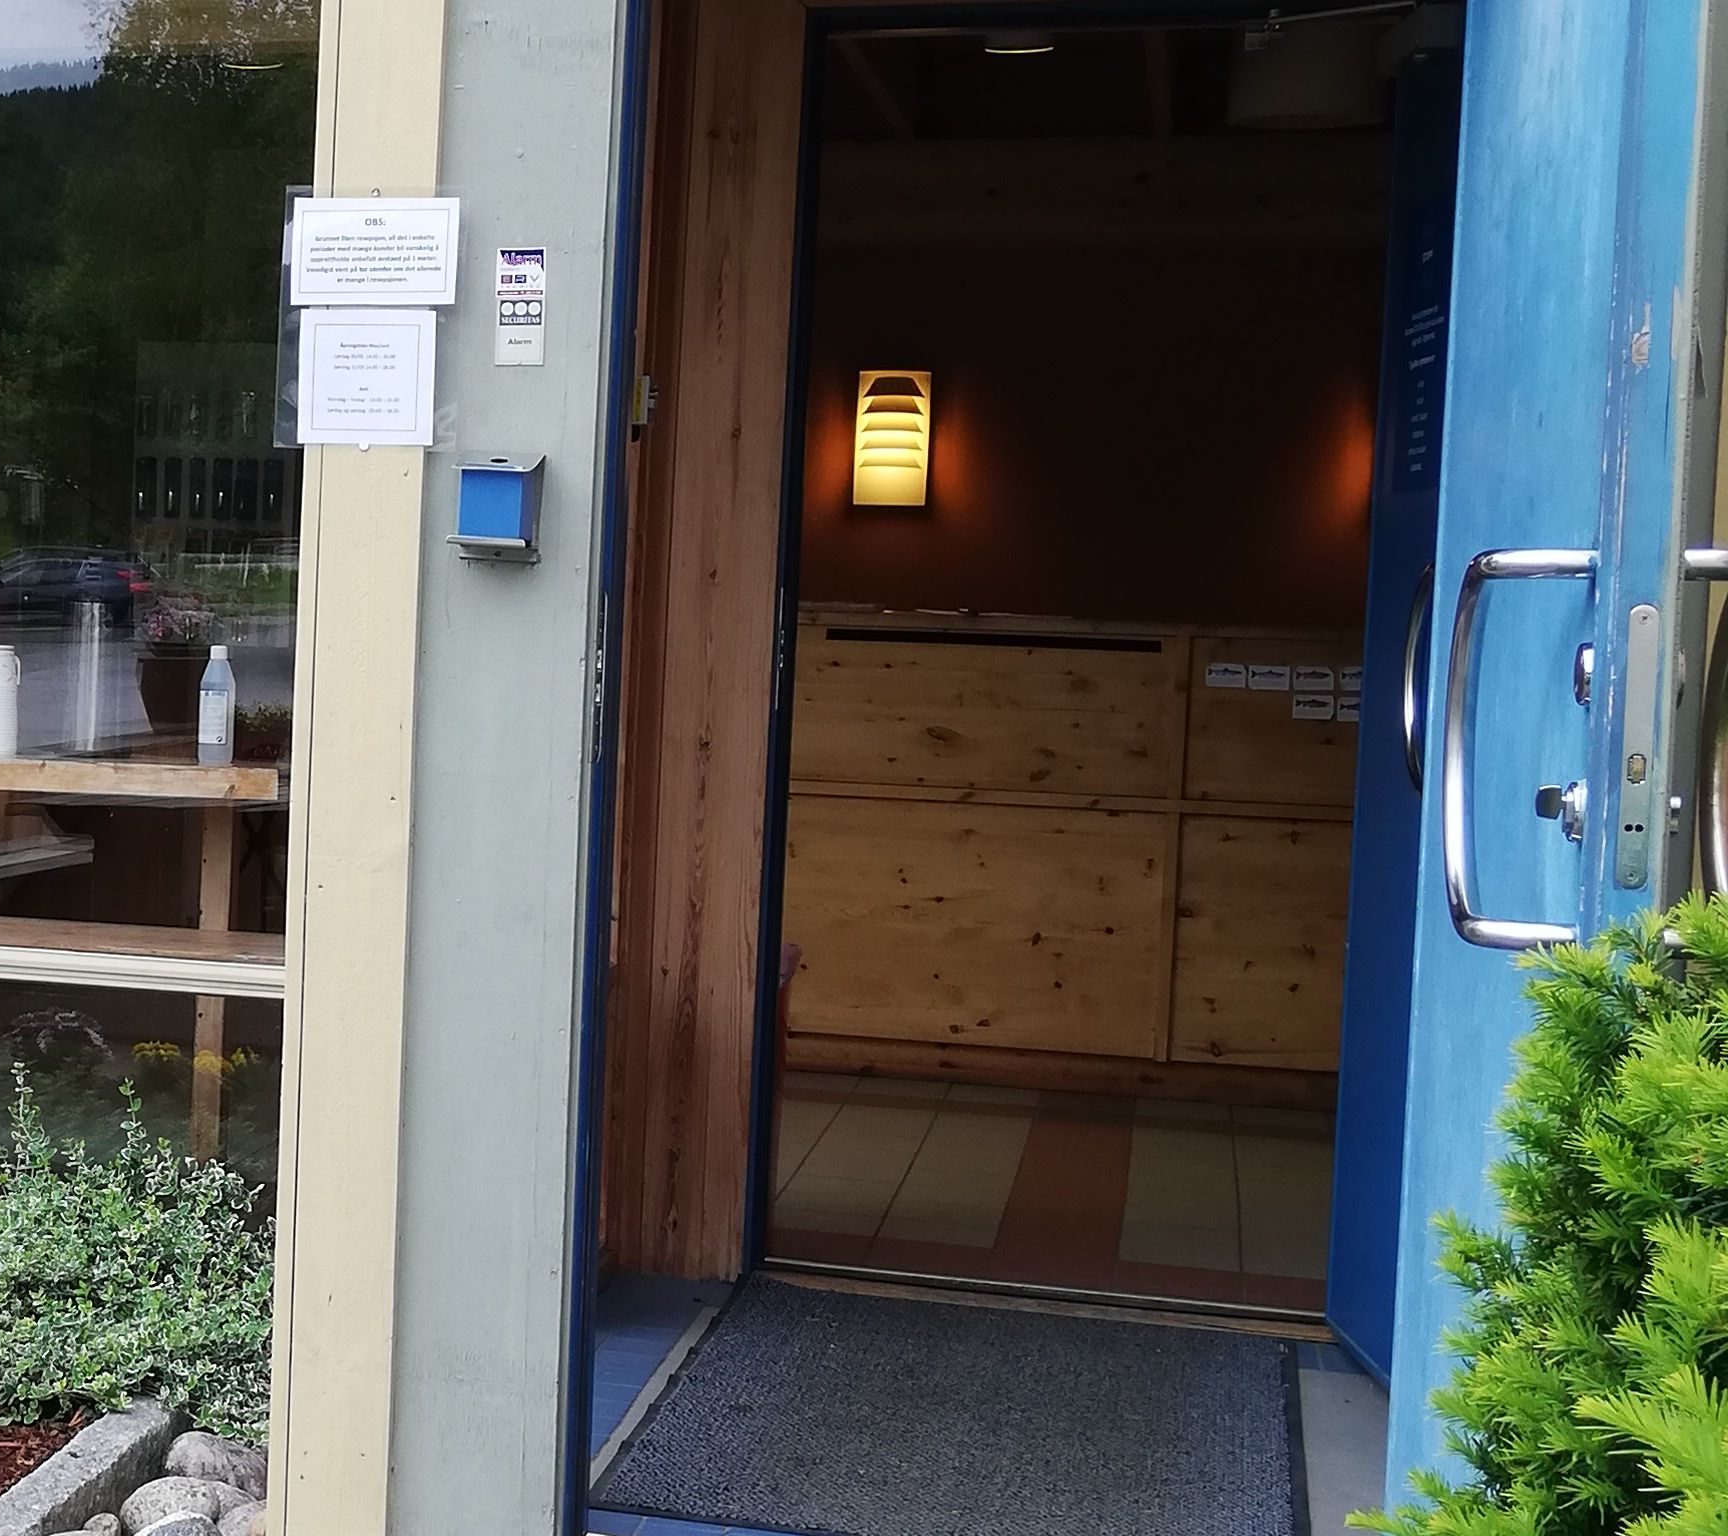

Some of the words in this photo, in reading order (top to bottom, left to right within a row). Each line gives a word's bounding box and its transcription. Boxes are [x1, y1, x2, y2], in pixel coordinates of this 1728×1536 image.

[365, 218, 386, 226] OBS:
[502, 252, 543, 266] Alarm
[501, 316, 540, 324] SECURITAS
